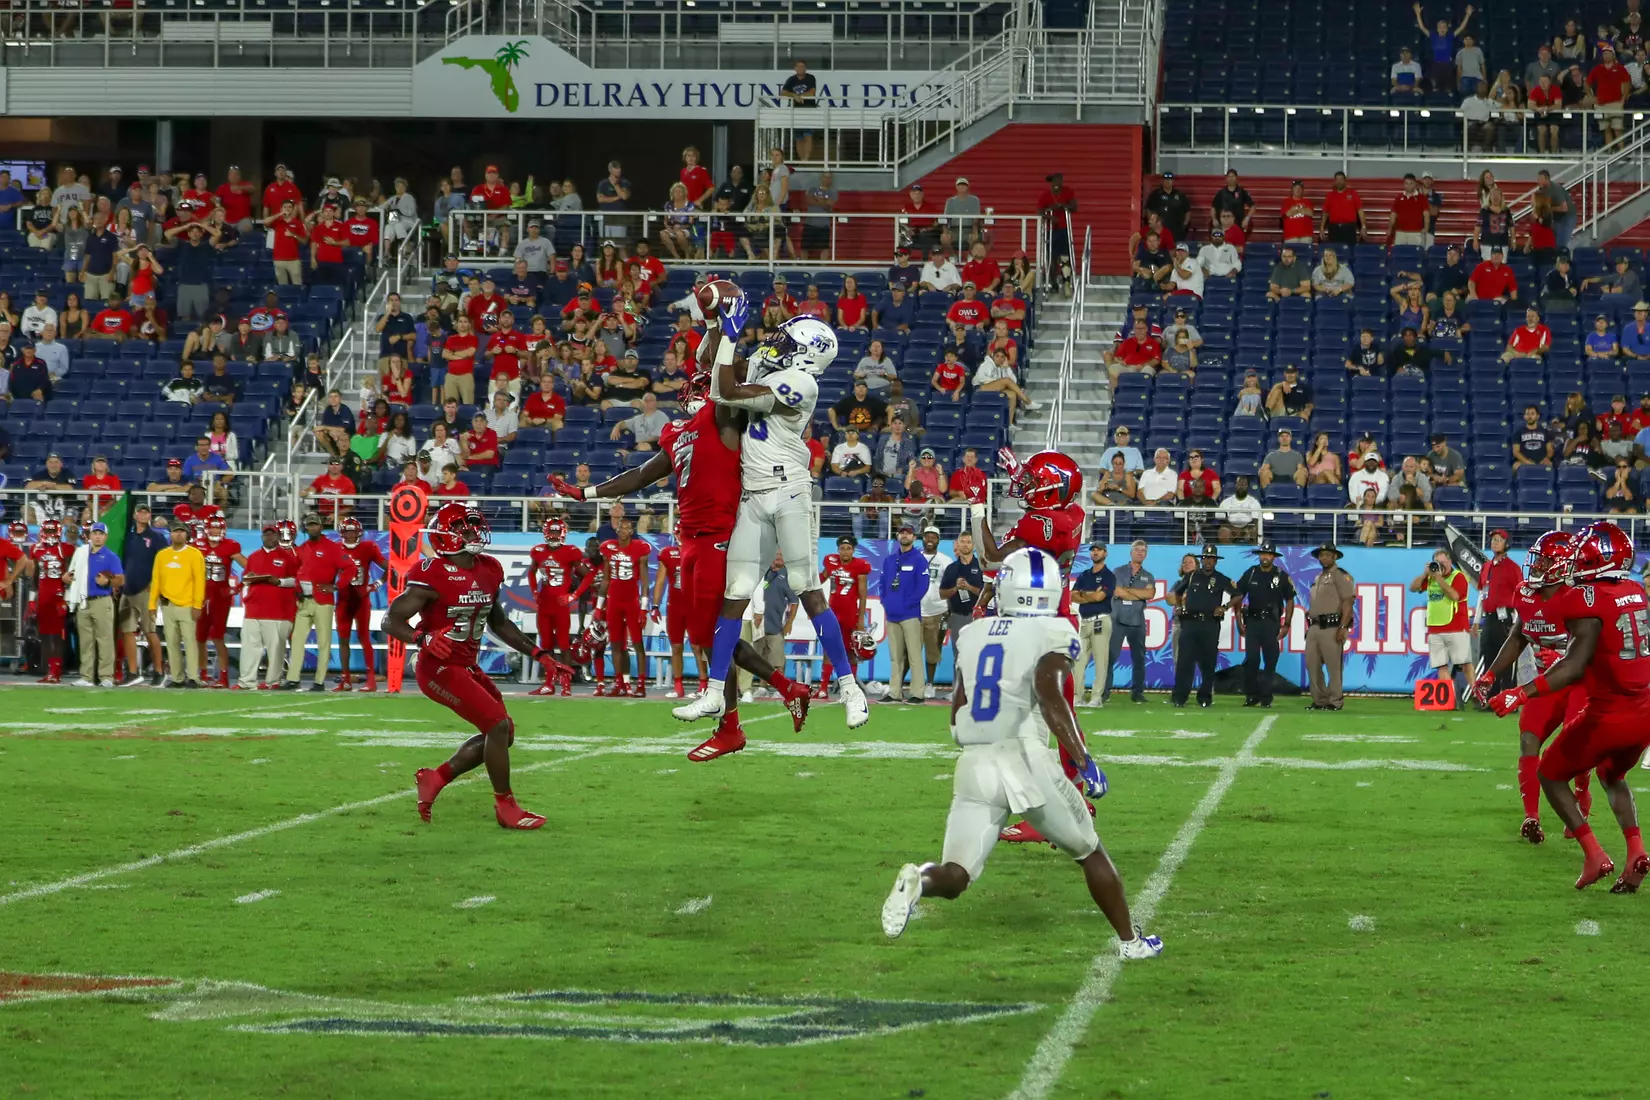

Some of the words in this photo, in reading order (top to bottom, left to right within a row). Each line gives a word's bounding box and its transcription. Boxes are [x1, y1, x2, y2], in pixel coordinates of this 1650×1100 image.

[534, 82, 673, 107] DELRAY
[681, 82, 850, 108] HYUNAI
[958, 309, 979, 317] OWLS
[1026, 596, 1033, 606] 8
[988, 620, 1013, 636] LEE
[1616, 609, 1650, 660] 15
[971, 643, 1005, 722] 8
[1420, 683, 1448, 705] 20
